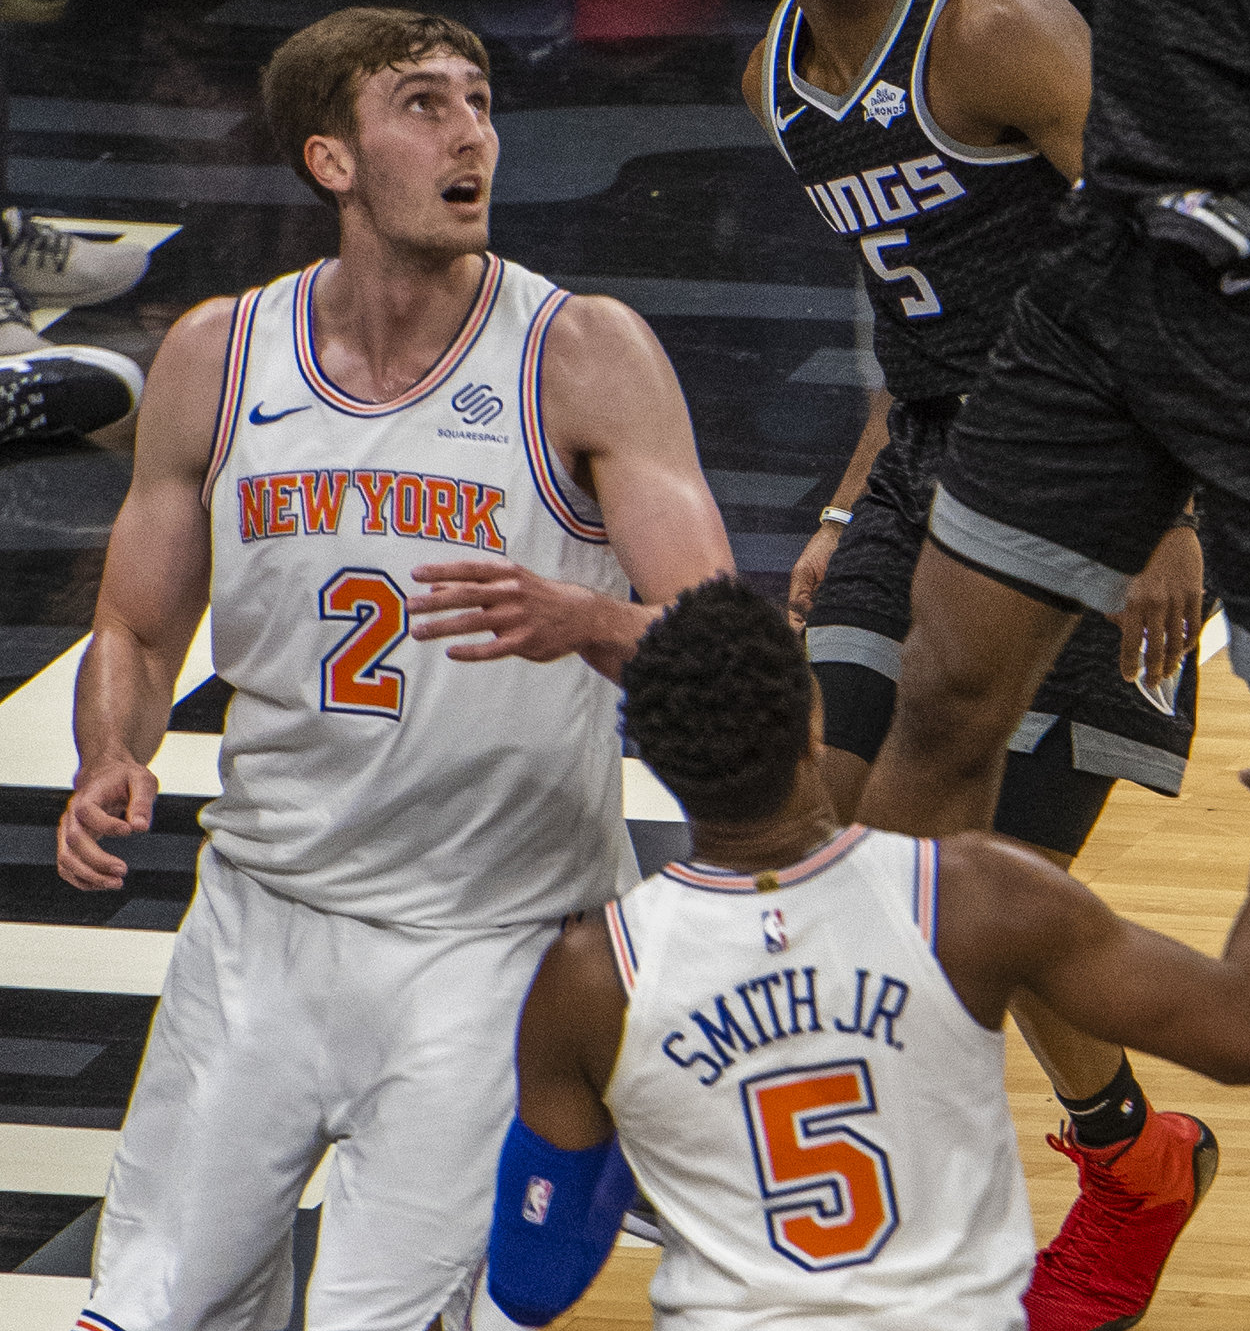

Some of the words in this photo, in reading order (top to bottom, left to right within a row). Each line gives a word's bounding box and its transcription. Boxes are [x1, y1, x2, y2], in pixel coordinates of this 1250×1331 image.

[804, 154, 967, 234] INGS
[860, 228, 943, 318] 5
[437, 428, 510, 444] SQUARESPACE
[237, 469, 350, 544] NEW
[352, 468, 507, 556] YORK
[317, 566, 409, 722] 2
[661, 966, 823, 1087] SMITH
[738, 1057, 900, 1274] 5
